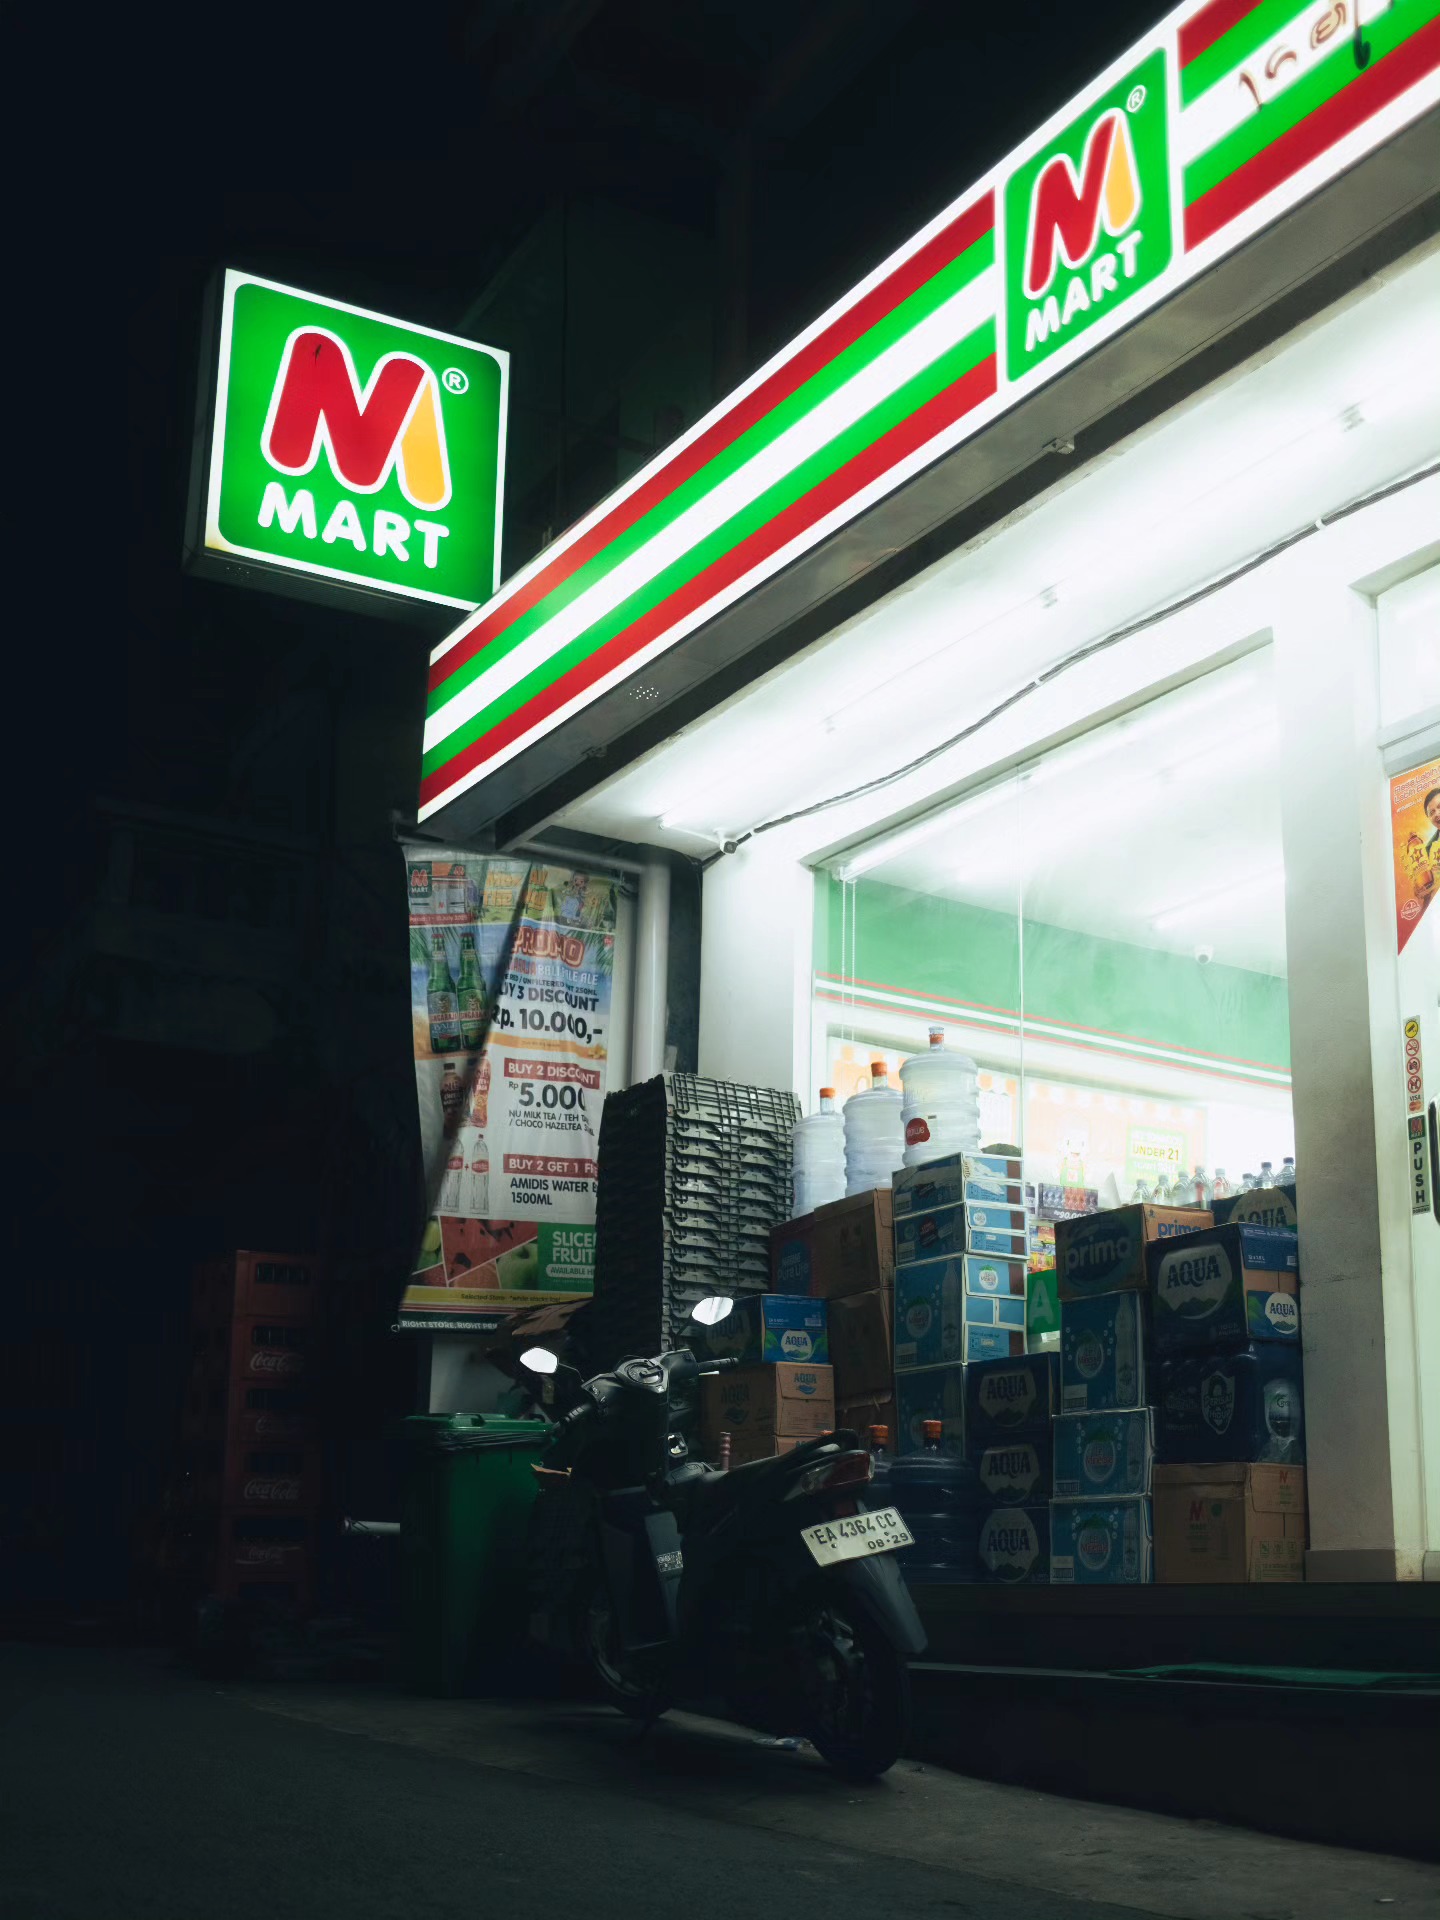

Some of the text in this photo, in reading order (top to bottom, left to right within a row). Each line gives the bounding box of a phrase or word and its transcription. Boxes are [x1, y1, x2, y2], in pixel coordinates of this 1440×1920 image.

[1025, 230, 1143, 352] MART
[258, 481, 450, 569] MART
[580, 972, 599, 985] ALE
[517, 985, 525, 1000] 3
[508, 1062, 532, 1075] BUY
[536, 1064, 544, 1076] 2
[509, 1081, 518, 1091] Rp
[509, 1110, 521, 1118] NU
[523, 1111, 540, 1120] MILK
[542, 1112, 556, 1121] TEA
[563, 1113, 579, 1123] TEH
[514, 1119, 543, 1128] CHOCO
[545, 1122, 582, 1131] HAZELTEA
[1132, 1144, 1179, 1162] UNDER 21
[509, 1159, 533, 1169] BUY
[536, 1160, 543, 1171] 2
[547, 1162, 569, 1173] GET
[1413, 1142, 1425, 1204] PUSH
[510, 1177, 550, 1191] AMIDIS
[552, 1180, 588, 1193] WATER
[511, 1191, 553, 1206] 1500ML
[1065, 1235, 1131, 1278] prima
[549, 1267, 586, 1276] AVAILABLE
[1167, 1255, 1222, 1290] AQUA
[1270, 1303, 1296, 1317] AQUA
[401, 1319, 426, 1329] RIGHT
[785, 1335, 808, 1347] AQUA
[794, 1373, 817, 1384] AQUA
[987, 1376, 1028, 1402] AQUA
[988, 1453, 1030, 1479] AQUA
[813, 1512, 897, 1545] EA 4364 CC
[987, 1529, 1029, 1556] AQUA
